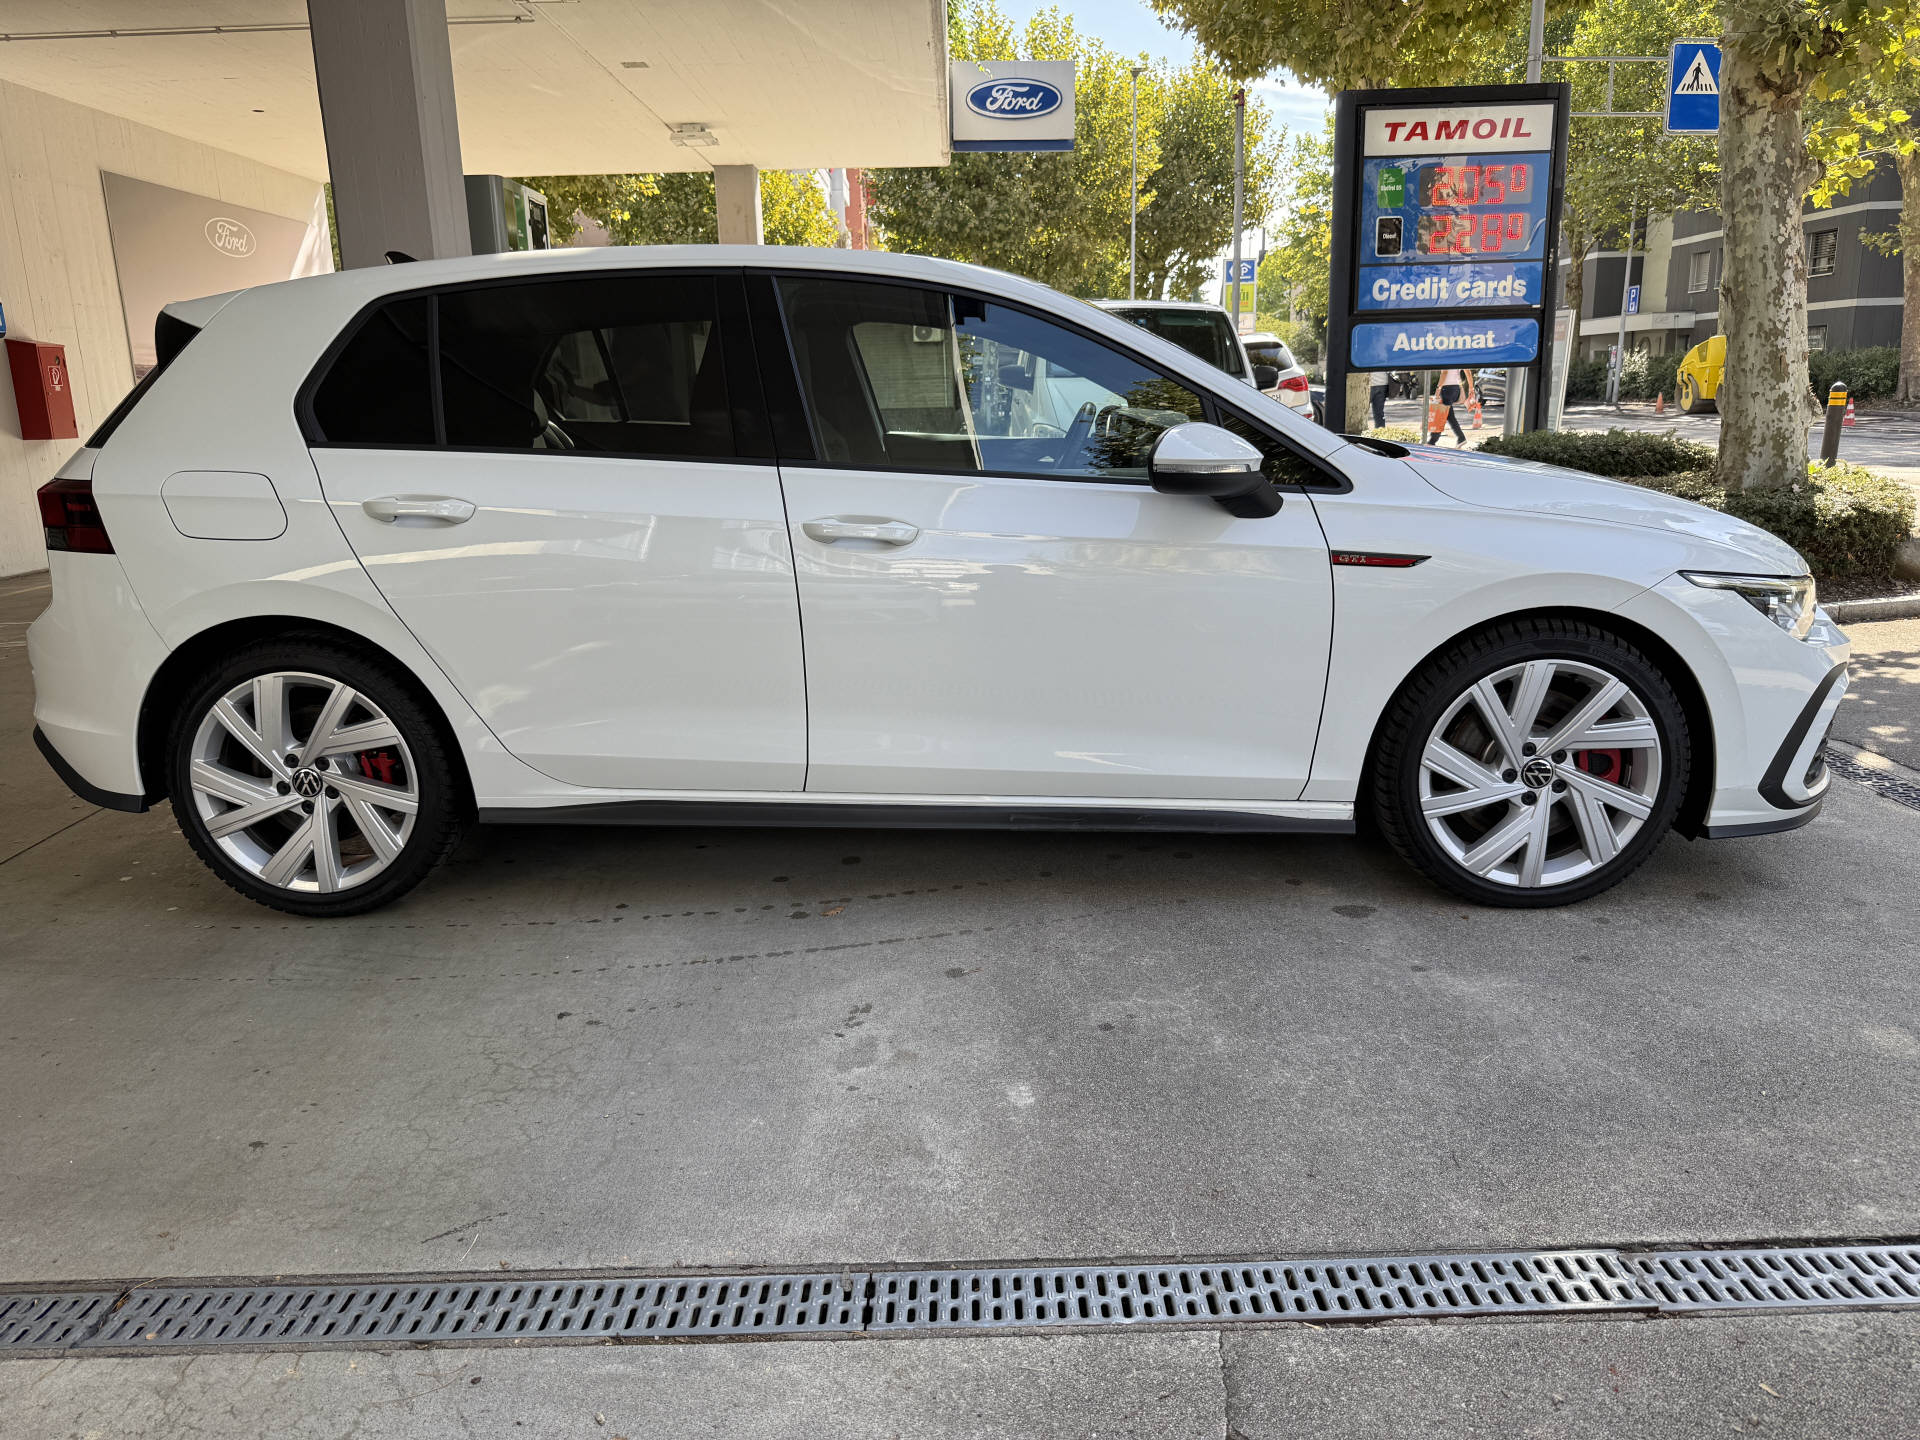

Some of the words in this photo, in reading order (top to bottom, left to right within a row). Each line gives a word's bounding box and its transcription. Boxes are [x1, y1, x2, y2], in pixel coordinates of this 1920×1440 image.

[986, 85, 1043, 110] Ford
[1384, 117, 1532, 142] TAMOIL
[215, 221, 248, 253] Ford
[1372, 276, 1450, 302] Credit
[1456, 275, 1527, 300] cards
[1392, 330, 1496, 352] Automat
[1339, 554, 1367, 564] GTI
